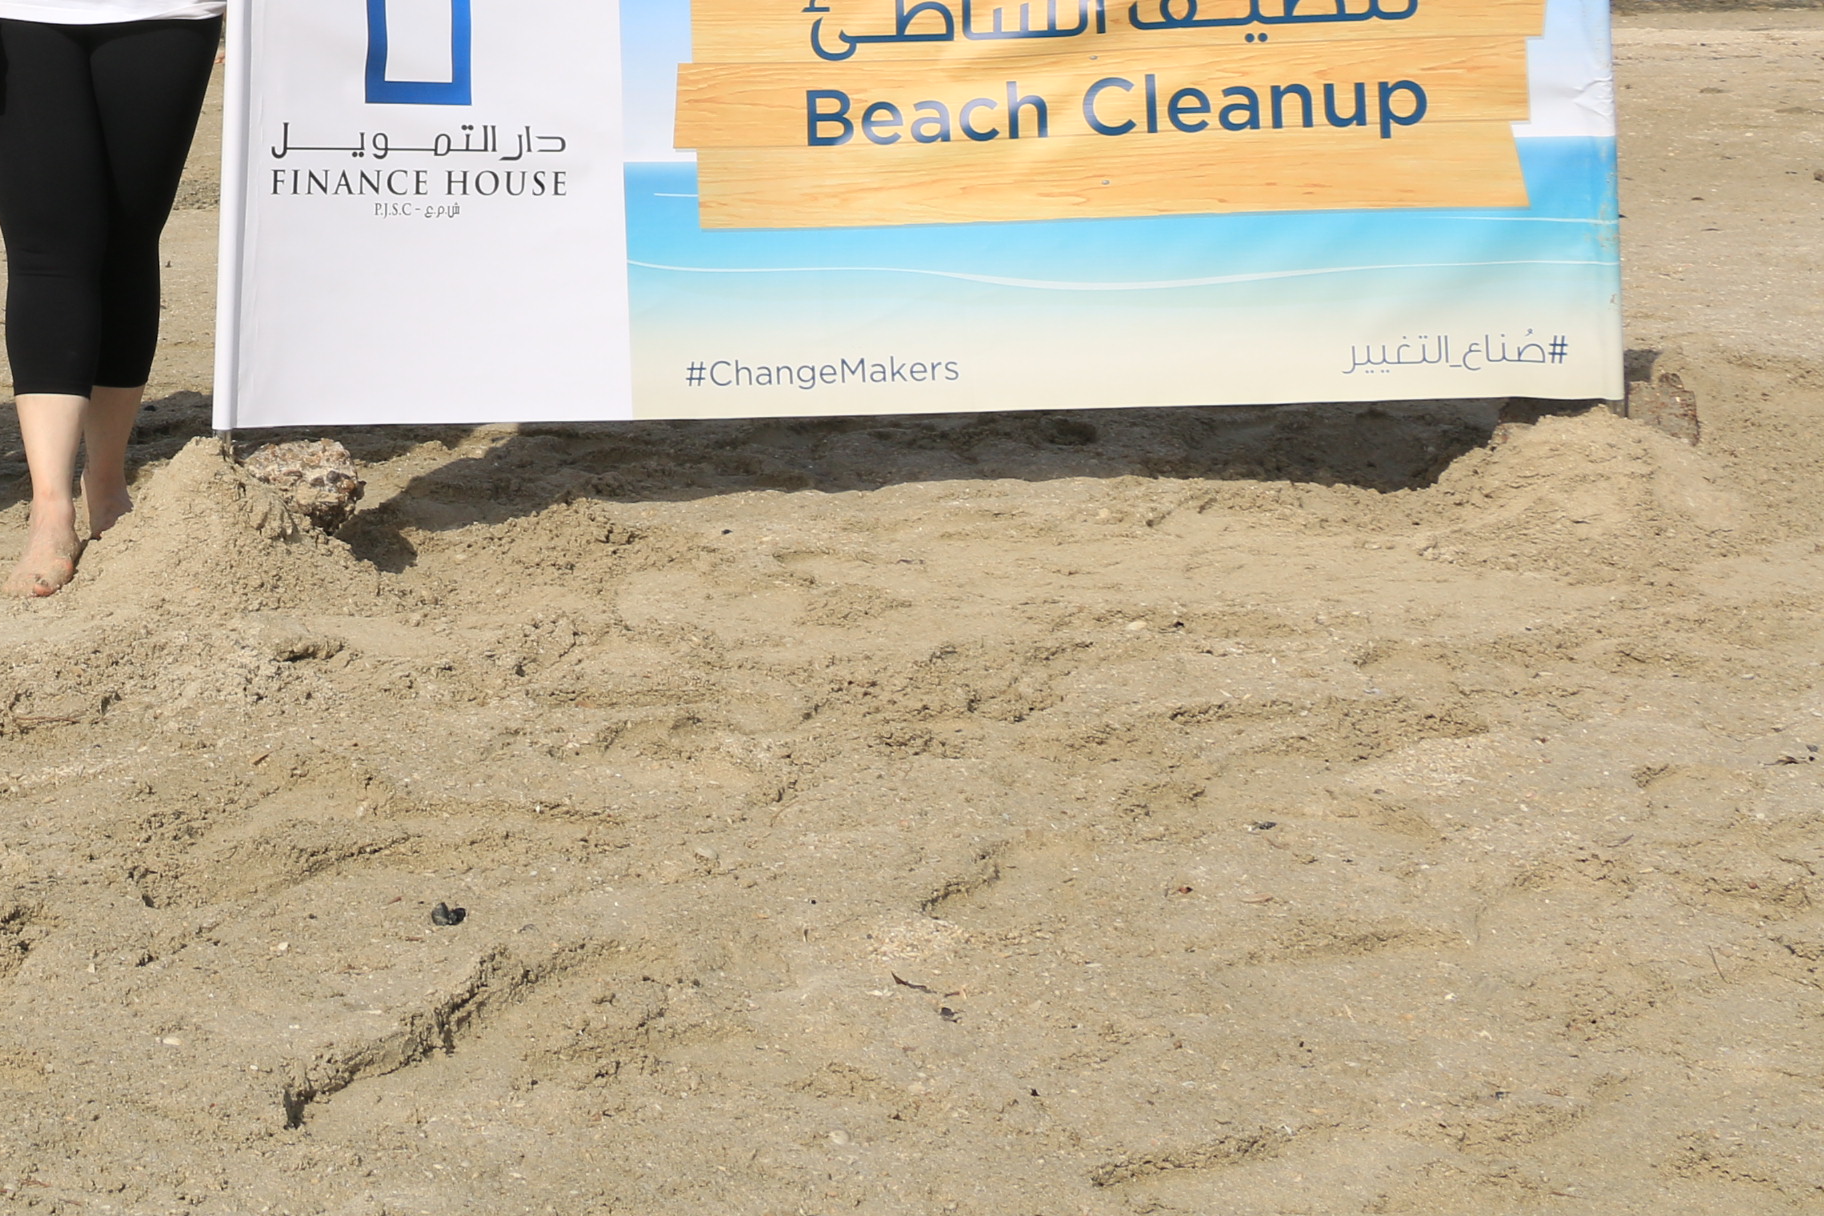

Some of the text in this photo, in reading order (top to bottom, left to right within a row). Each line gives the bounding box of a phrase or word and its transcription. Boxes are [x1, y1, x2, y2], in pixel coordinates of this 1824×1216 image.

[806, 73, 1427, 146] Beach Cleanup
[498, 125, 567, 161] دار
[271, 168, 567, 196] FINANCE HOUSE
[374, 202, 413, 219] P.J.S.C
[685, 355, 960, 390] #ChangeMakers
